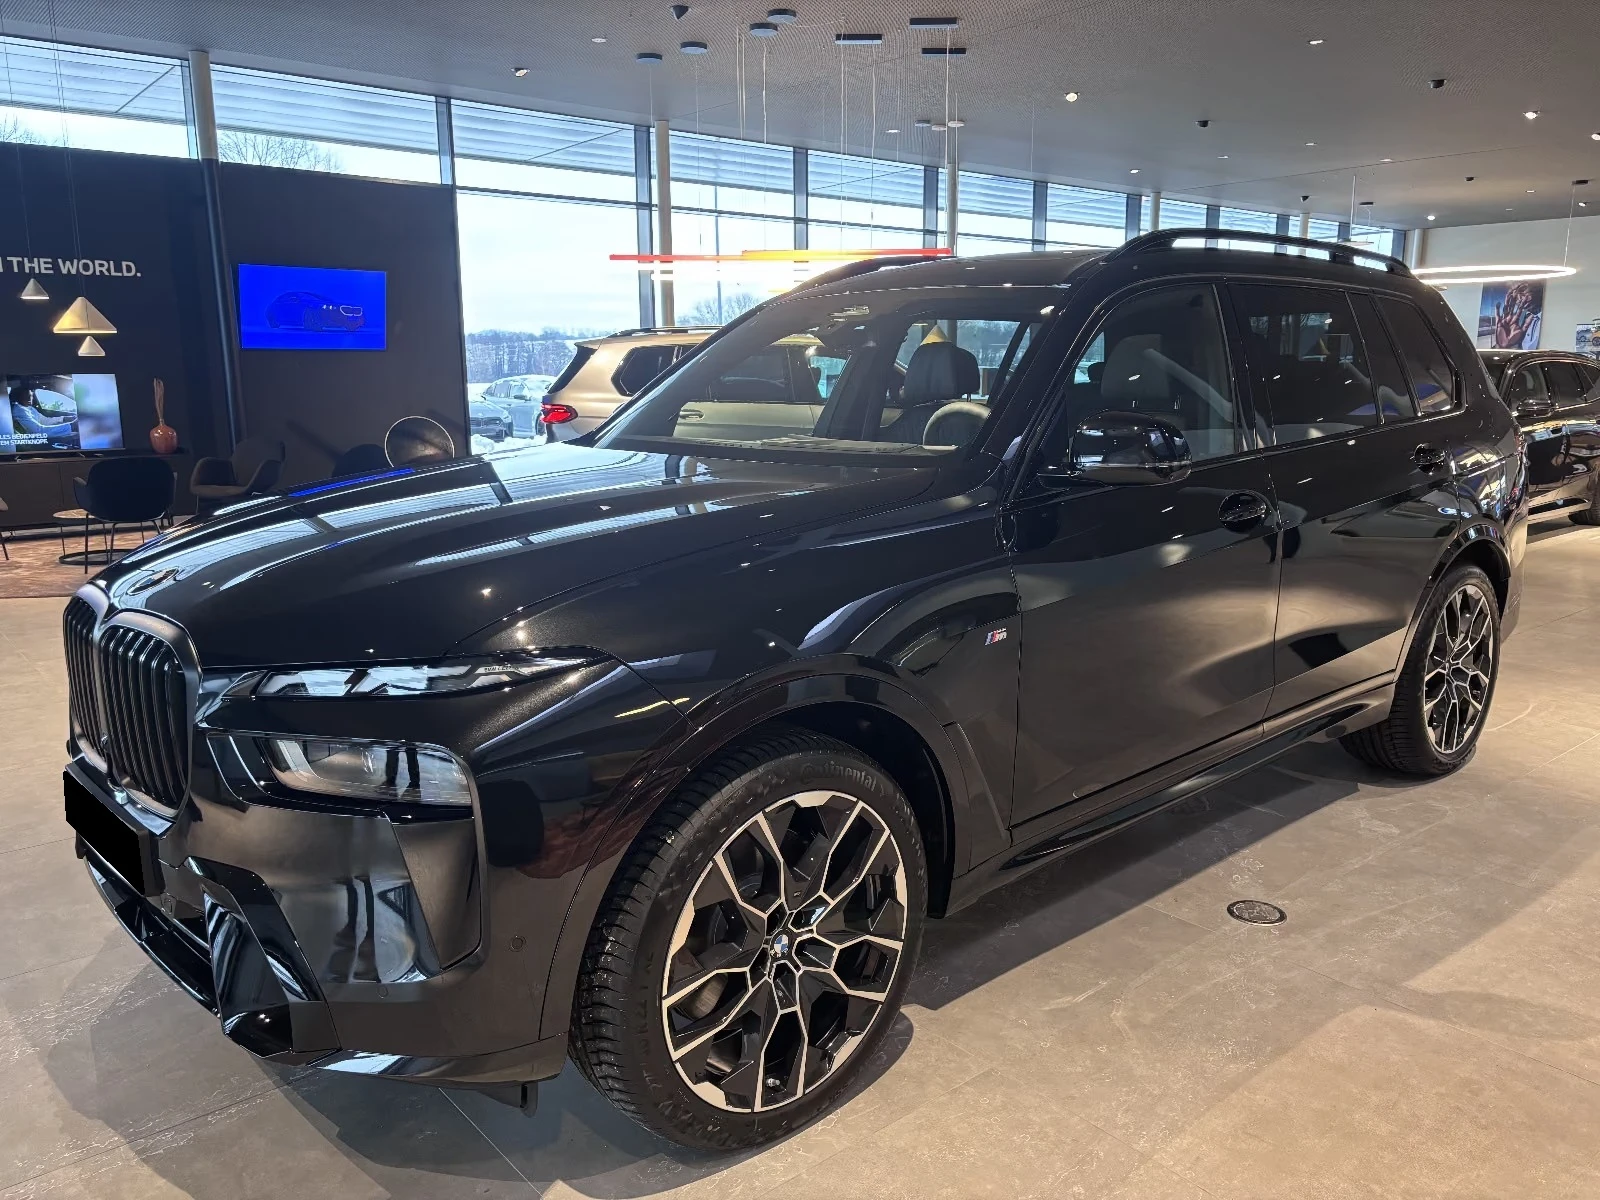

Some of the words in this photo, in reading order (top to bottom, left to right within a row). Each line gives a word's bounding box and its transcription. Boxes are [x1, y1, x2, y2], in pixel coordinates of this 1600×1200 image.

[6, 256, 54, 274] THE
[57, 258, 142, 277] WORLD.
[801, 760, 877, 792] Ctinental
